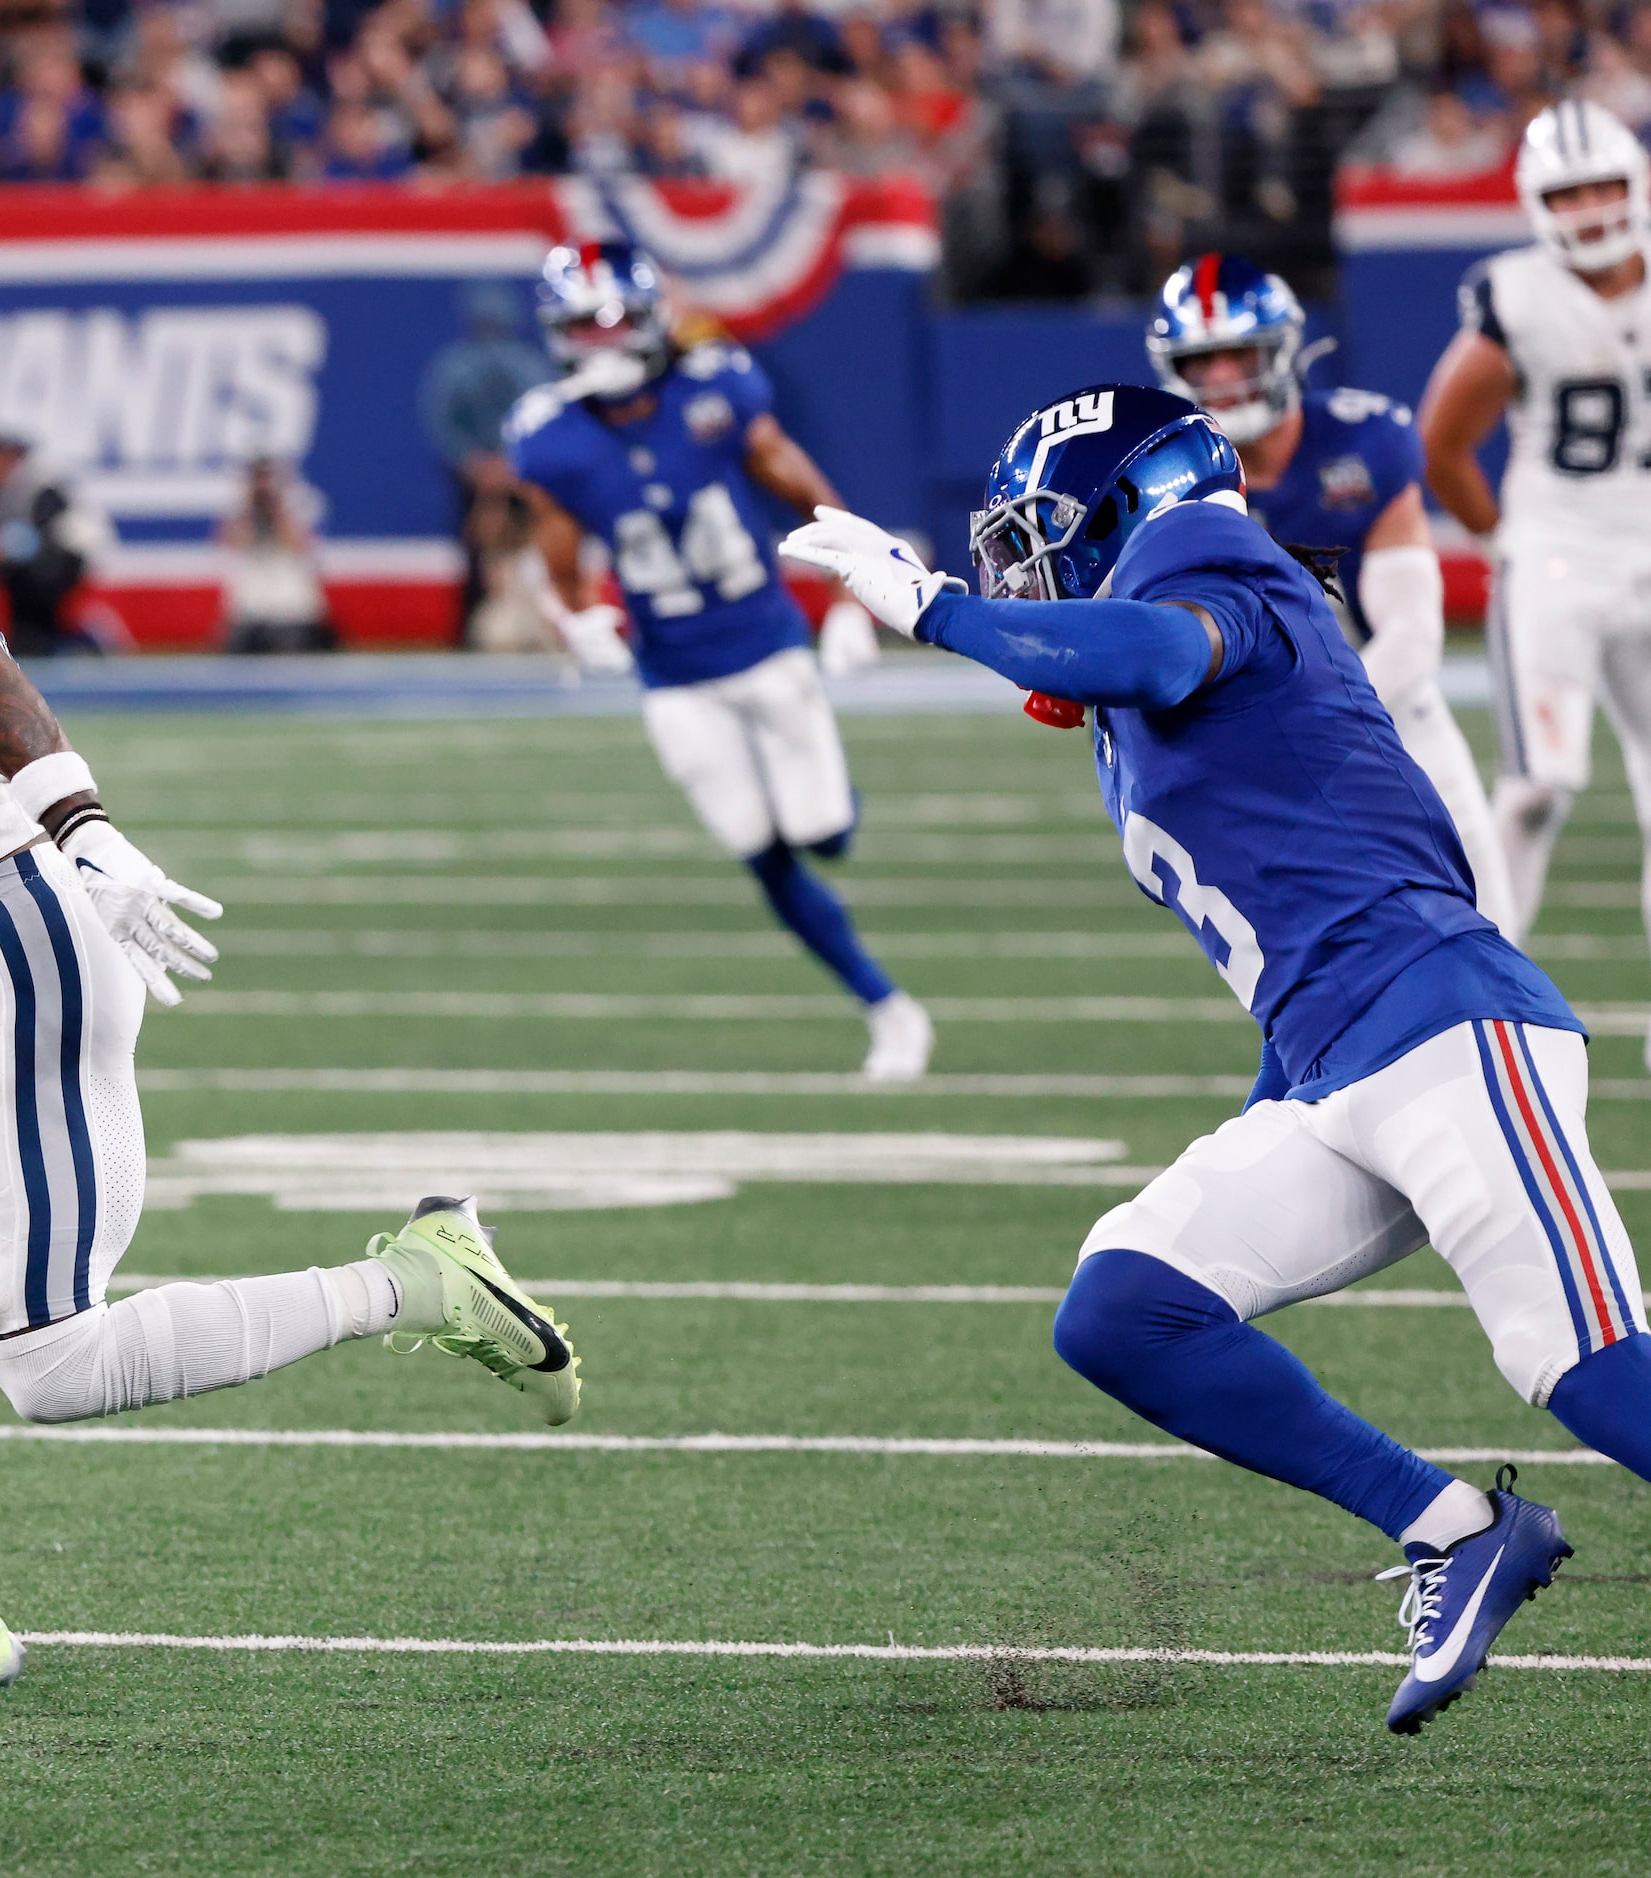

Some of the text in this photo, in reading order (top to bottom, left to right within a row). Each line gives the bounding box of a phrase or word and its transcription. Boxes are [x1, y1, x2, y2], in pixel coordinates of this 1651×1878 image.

[1552, 374, 1651, 474] 8
[613, 481, 768, 618] 44
[1123, 810, 1265, 1012] 3
